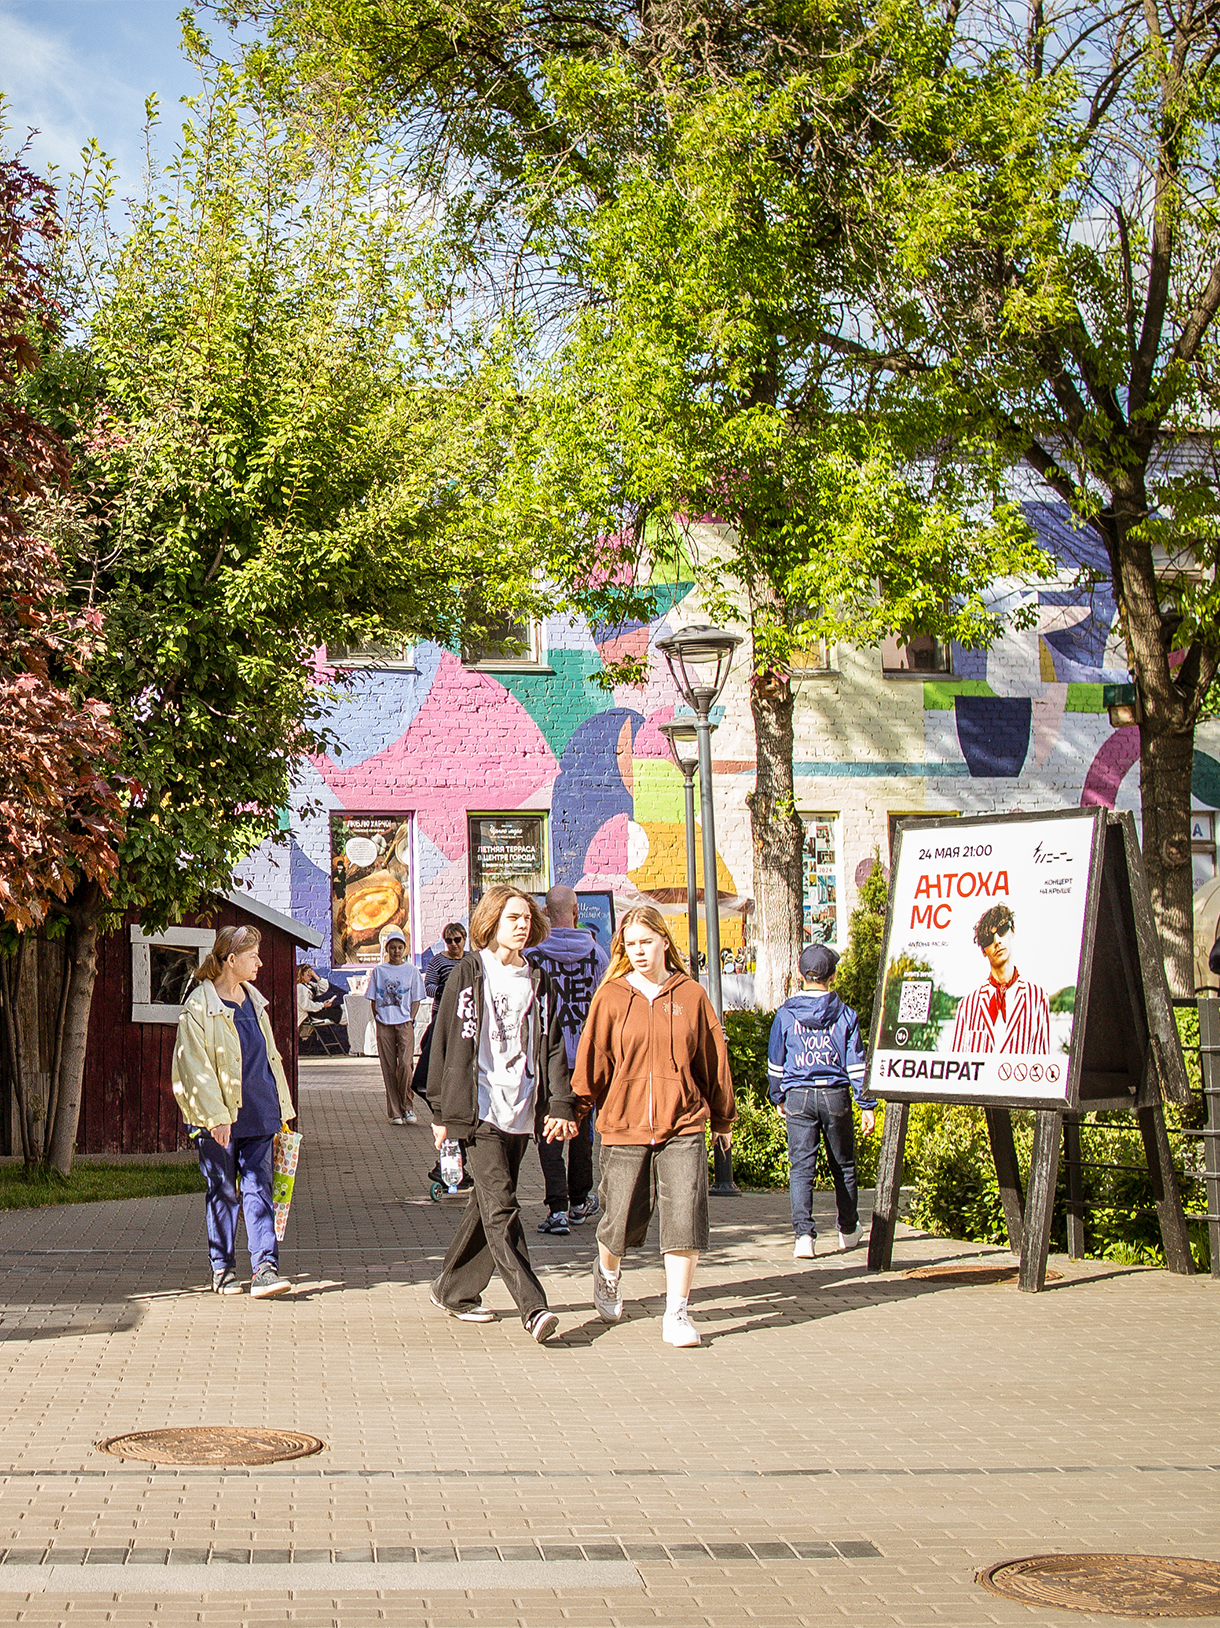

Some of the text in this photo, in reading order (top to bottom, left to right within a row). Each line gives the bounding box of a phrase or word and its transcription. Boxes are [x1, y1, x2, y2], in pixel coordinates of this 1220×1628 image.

[477, 845, 536, 854] ЛЕТНЯЯ ТЕРРАСА
[918, 844, 993, 860] 24 МАЯ 21:00
[483, 853, 509, 862] ЦЕНТРЕ
[509, 854, 536, 862] ГОРОДА
[913, 870, 1010, 899] АНТОХА
[1044, 878, 1073, 886] КОНЦЕРТ
[800, 1035, 833, 1052] YOUR
